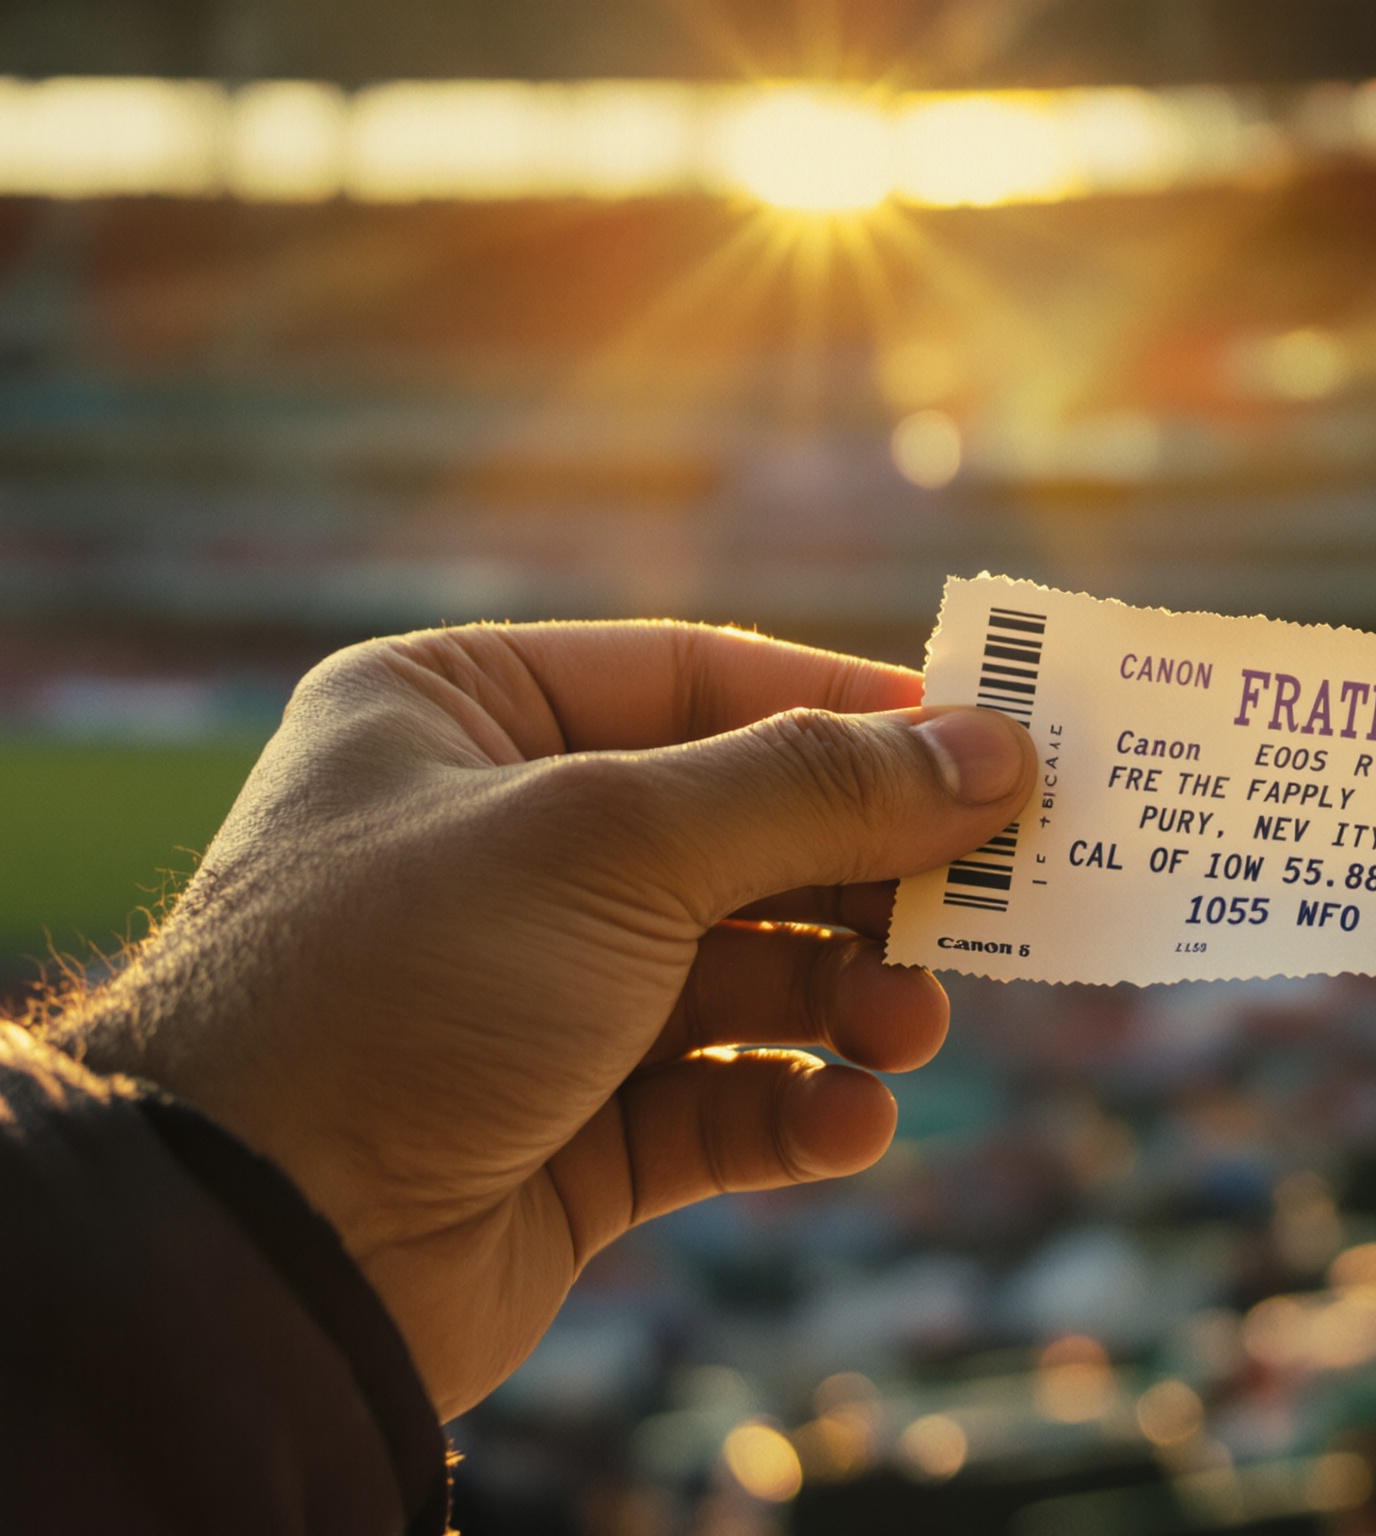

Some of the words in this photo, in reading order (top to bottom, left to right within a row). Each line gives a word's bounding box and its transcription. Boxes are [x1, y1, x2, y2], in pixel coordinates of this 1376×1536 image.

[1119, 653, 1214, 690] CANON
[1116, 729, 1201, 762] Canon
[1107, 765, 1163, 793] FRE
[1178, 772, 1231, 800] THE
[1246, 778, 1356, 811] FAPPLY
[1138, 804, 1225, 839] PURY,
[1252, 814, 1311, 843] NEV
[1068, 839, 1123, 871] CAL
[1149, 846, 1190, 875] OF
[1184, 894, 1271, 926] 1055
[1295, 899, 1361, 933] WFO
